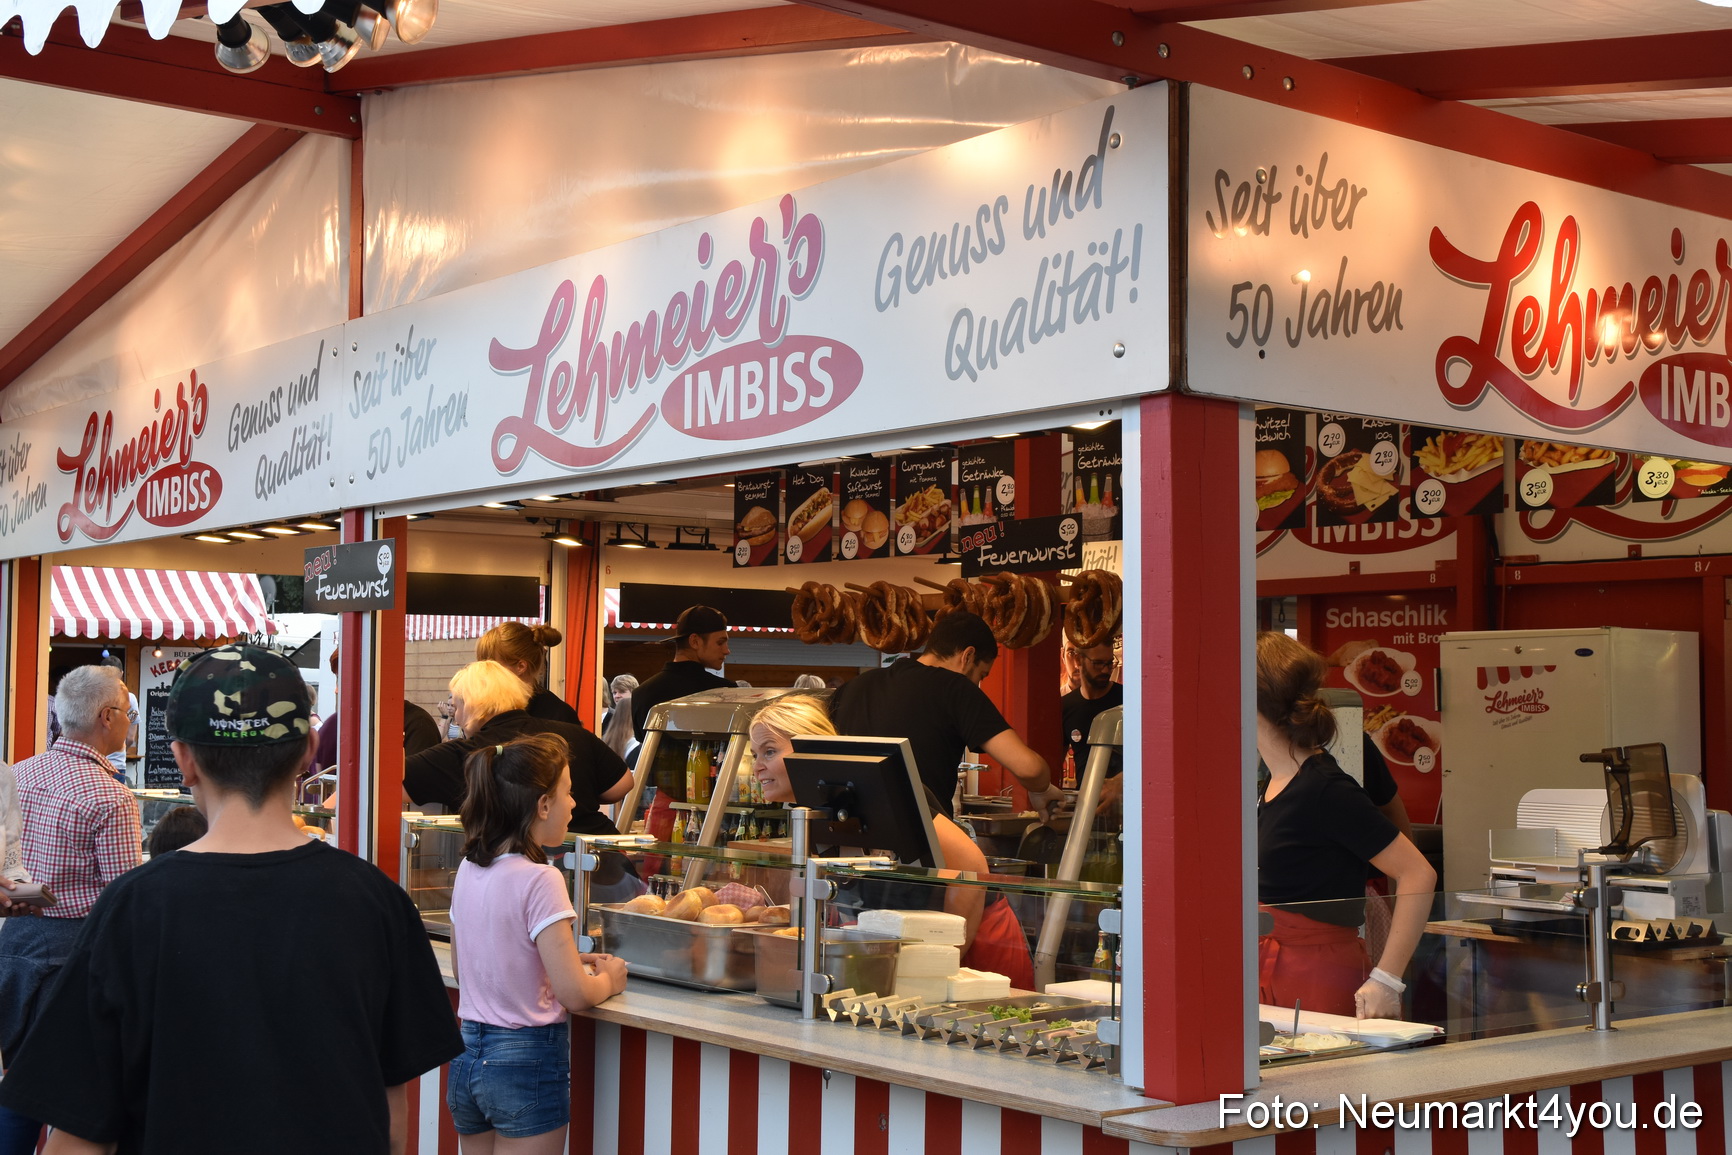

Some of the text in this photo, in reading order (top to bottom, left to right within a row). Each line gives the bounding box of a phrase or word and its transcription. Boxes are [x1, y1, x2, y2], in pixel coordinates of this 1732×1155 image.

[875, 104, 1116, 313] Genuss und
[1206, 151, 1368, 240] Seit über
[945, 223, 1144, 383] Qualität!
[1226, 254, 1404, 350] 50 Jahren
[488, 193, 825, 475] Lehmeier's
[348, 324, 437, 420] Seit über
[228, 338, 325, 453] Genuss und
[683, 346, 835, 432] IMBISS
[1660, 363, 1732, 429] IMB
[366, 380, 470, 481] 50 Jahren
[57, 368, 209, 543] Lehmeier's
[254, 412, 333, 500] Qualität!
[901, 457, 945, 477] Currywurst
[145, 468, 212, 519] IMBISS
[792, 472, 826, 487] Hot Dog
[1525, 480, 1547, 498] 3,50
[1645, 471, 1670, 488] 3,30
[11, 474, 48, 534] Jahren
[1421, 488, 1442, 505] 3,00
[961, 521, 1005, 553] neu!
[304, 545, 337, 582] neu!
[977, 543, 1076, 567] Feuerwurst
[1695, 561, 1702, 573] 8
[605, 565, 611, 575] 6
[1430, 573, 1436, 584] 8
[1514, 570, 1521, 581] 8
[316, 574, 390, 602] Feuerwurst
[1325, 604, 1448, 629] Schaschlik
[1393, 632, 1446, 645] mit Bro
[1484, 688, 1544, 714] Lehmeier's
[1521, 704, 1546, 712] IMBISS
[209, 717, 271, 731] MONSTER
[214, 730, 265, 738] ENERGY
